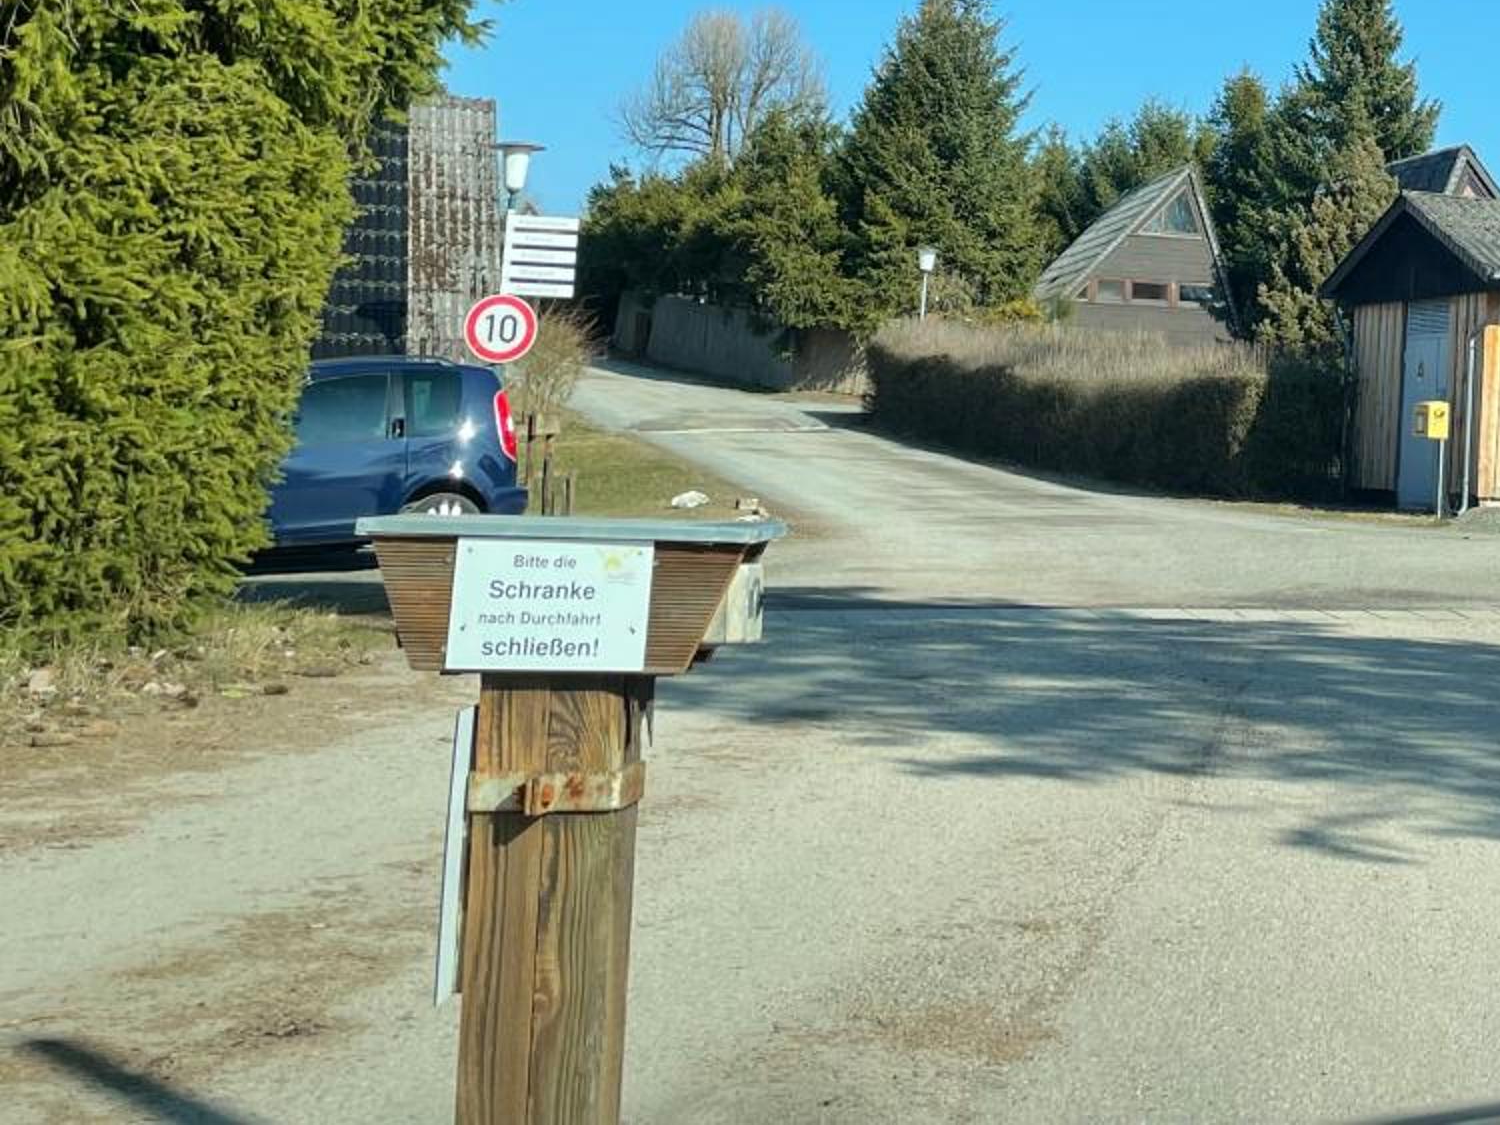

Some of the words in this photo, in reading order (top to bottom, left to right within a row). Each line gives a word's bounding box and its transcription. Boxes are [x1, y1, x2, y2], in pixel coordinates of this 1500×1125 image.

[486, 314, 518, 344] 10
[513, 554, 549, 569] Bitte
[553, 555, 577, 569] die
[489, 580, 596, 600] Schranke
[478, 611, 515, 625] nach
[520, 612, 601, 626] Durchfahrt
[481, 637, 599, 657] schließen!
